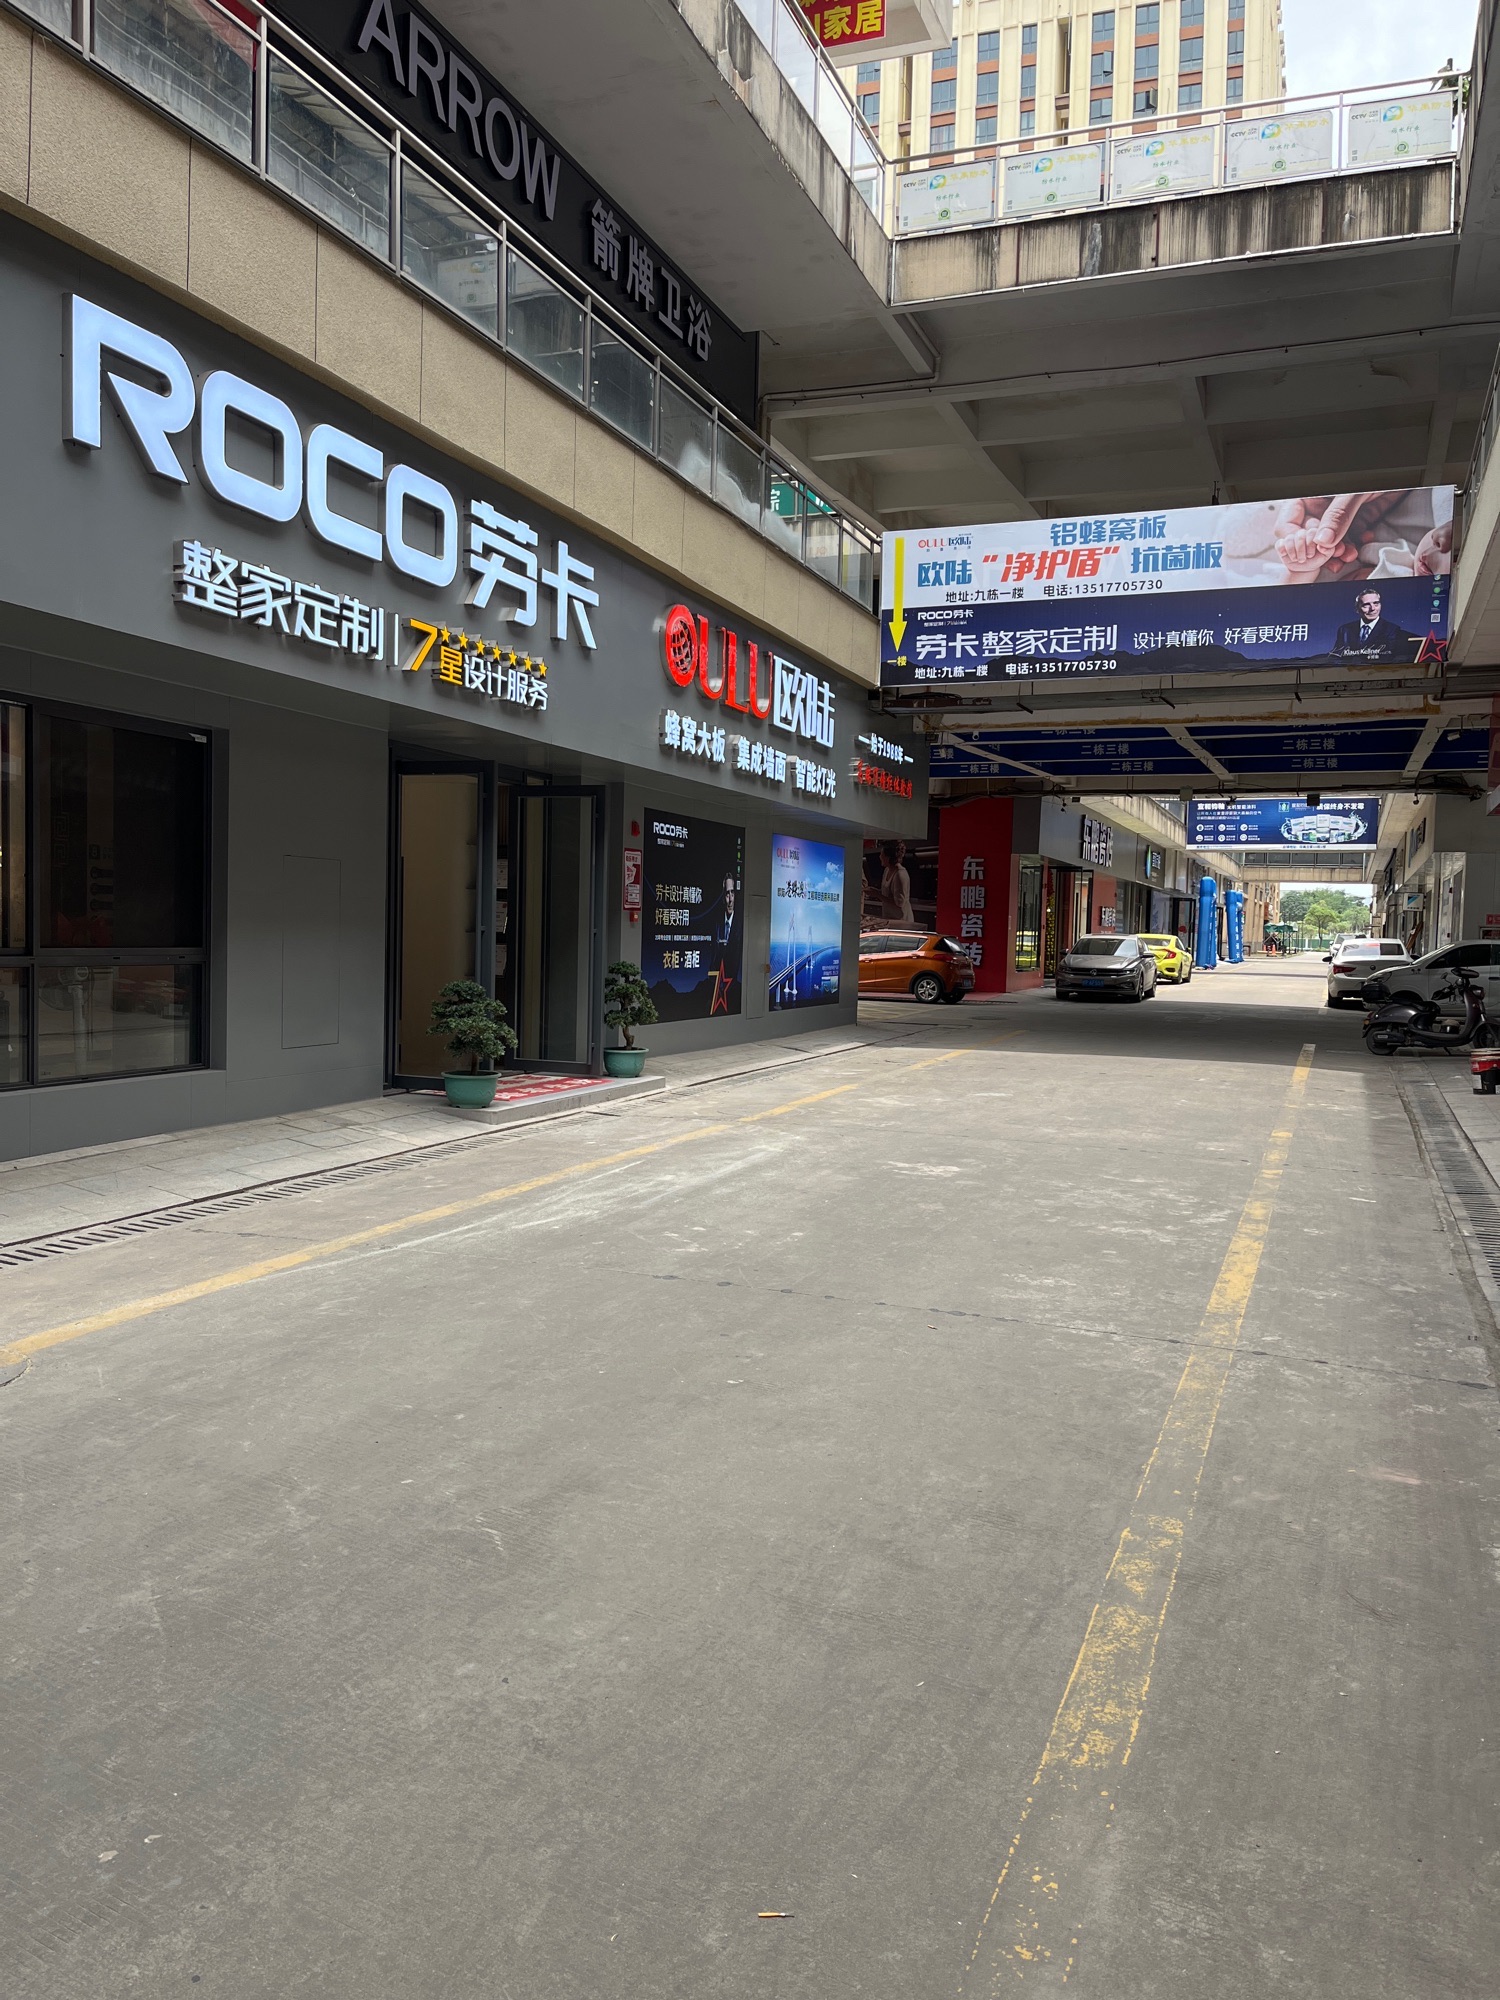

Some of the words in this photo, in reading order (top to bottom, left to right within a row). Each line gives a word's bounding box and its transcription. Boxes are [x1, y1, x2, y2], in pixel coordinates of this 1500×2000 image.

[812, 0, 883, 40] 家居
[358, 0, 561, 222] ARROW
[589, 199, 712, 362] 箭牌卫浴
[64, 293, 458, 587] ROCO
[464, 499, 600, 650] 劳卡
[1050, 514, 1167, 547] 铝蜂窝板
[917, 559, 972, 587] 欧陆
[1131, 541, 1223, 574] 抗菌板
[176, 539, 387, 661] 整家定制
[945, 586, 1025, 603] 地址:九栋一楼
[1043, 579, 1163, 597] 电话:13517705730
[917, 610, 952, 620] ROCO
[953, 609, 974, 619] 劳卡
[916, 624, 1118, 660] 劳卡整家定制
[1133, 628, 1215, 650] 设计真懂你
[1224, 622, 1309, 646] 好看更好用
[887, 655, 908, 667] 一楼
[914, 664, 989, 680] 地址:九栋一楼
[1005, 659, 1117, 676] 电话:13517705730
[662, 604, 773, 720] OULU
[771, 655, 837, 748] 欧陆
[662, 708, 727, 764] 蜂窝大板
[736, 735, 787, 784] 集成墙面
[794, 755, 837, 799] 智能灯光
[1081, 743, 1130, 756] 二栋三楼
[1282, 738, 1336, 751] 二栋三楼
[959, 763, 1000, 775] 二栋三楼
[1111, 761, 1154, 772] 二栋三楼
[1291, 757, 1339, 769] 二栋三楼
[653, 821, 676, 837] ROCO
[675, 825, 689, 839] 劳卡
[655, 883, 703, 904] 劳卡设计真懂你
[654, 907, 690, 927] 好看更好用
[960, 855, 985, 966] 东鹏瓷砖
